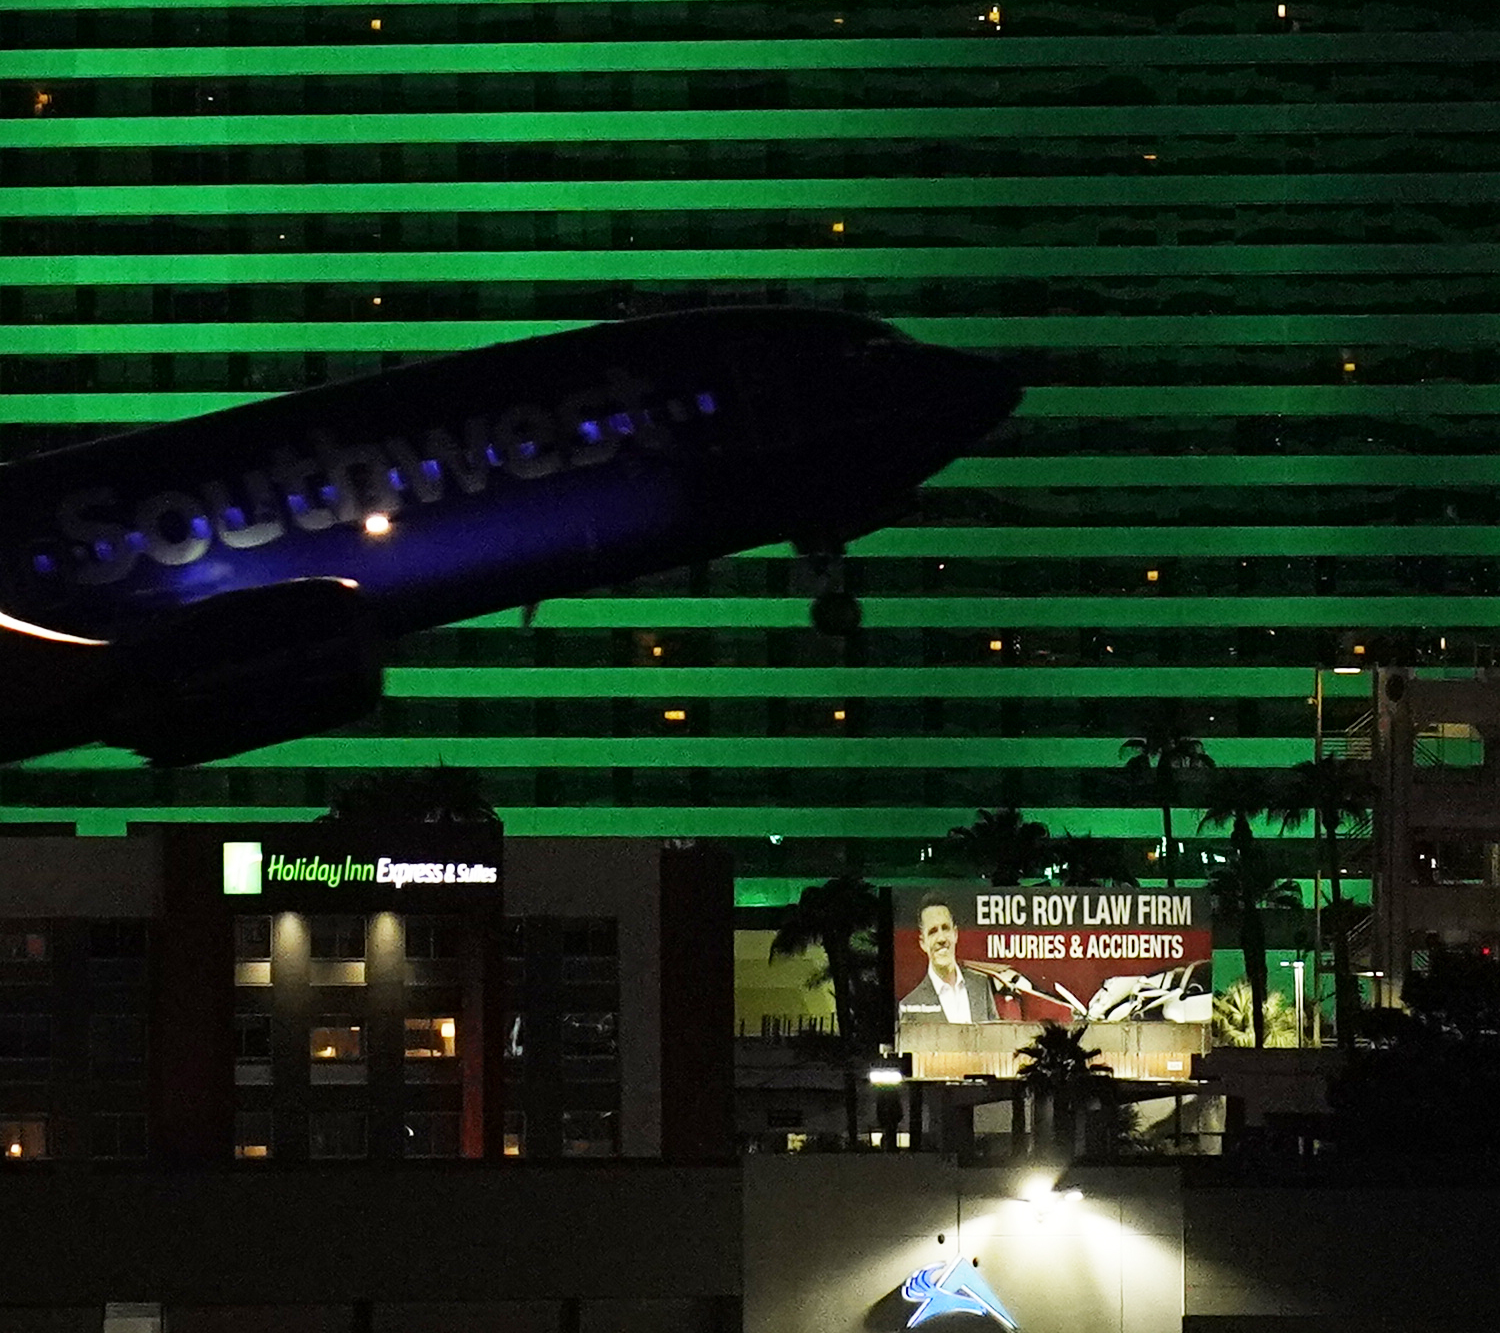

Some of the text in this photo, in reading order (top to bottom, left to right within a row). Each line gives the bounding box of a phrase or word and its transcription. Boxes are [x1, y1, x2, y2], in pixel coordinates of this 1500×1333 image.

[54, 365, 680, 587] Southwest
[267, 855, 343, 888] Holiday
[344, 856, 374, 881] Inn
[376, 857, 444, 888] Express
[444, 863, 456, 883] &
[976, 894, 1192, 926] ERIC ROY LAW FIRM
[987, 934, 1184, 959] INJURIES & ACCIDENTS
